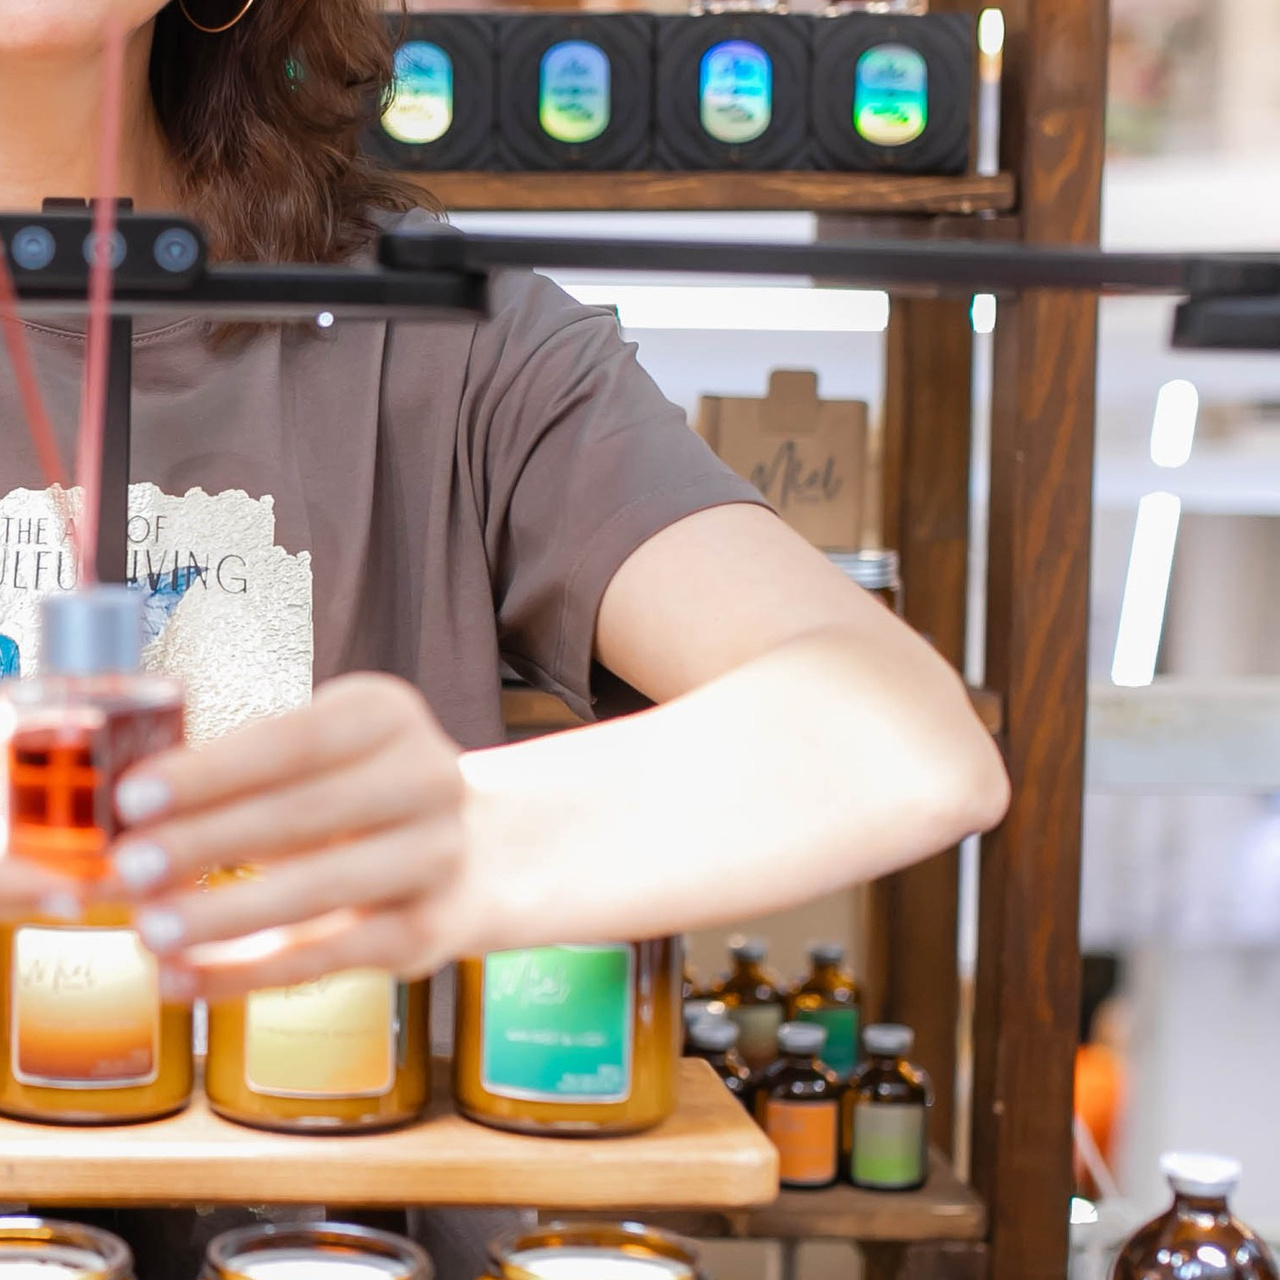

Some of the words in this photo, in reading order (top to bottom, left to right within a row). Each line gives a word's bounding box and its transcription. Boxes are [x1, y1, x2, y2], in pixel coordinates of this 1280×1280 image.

[4, 516, 48, 546] THE
[127, 515, 168, 544] OF
[126, 549, 247, 594] IVING
